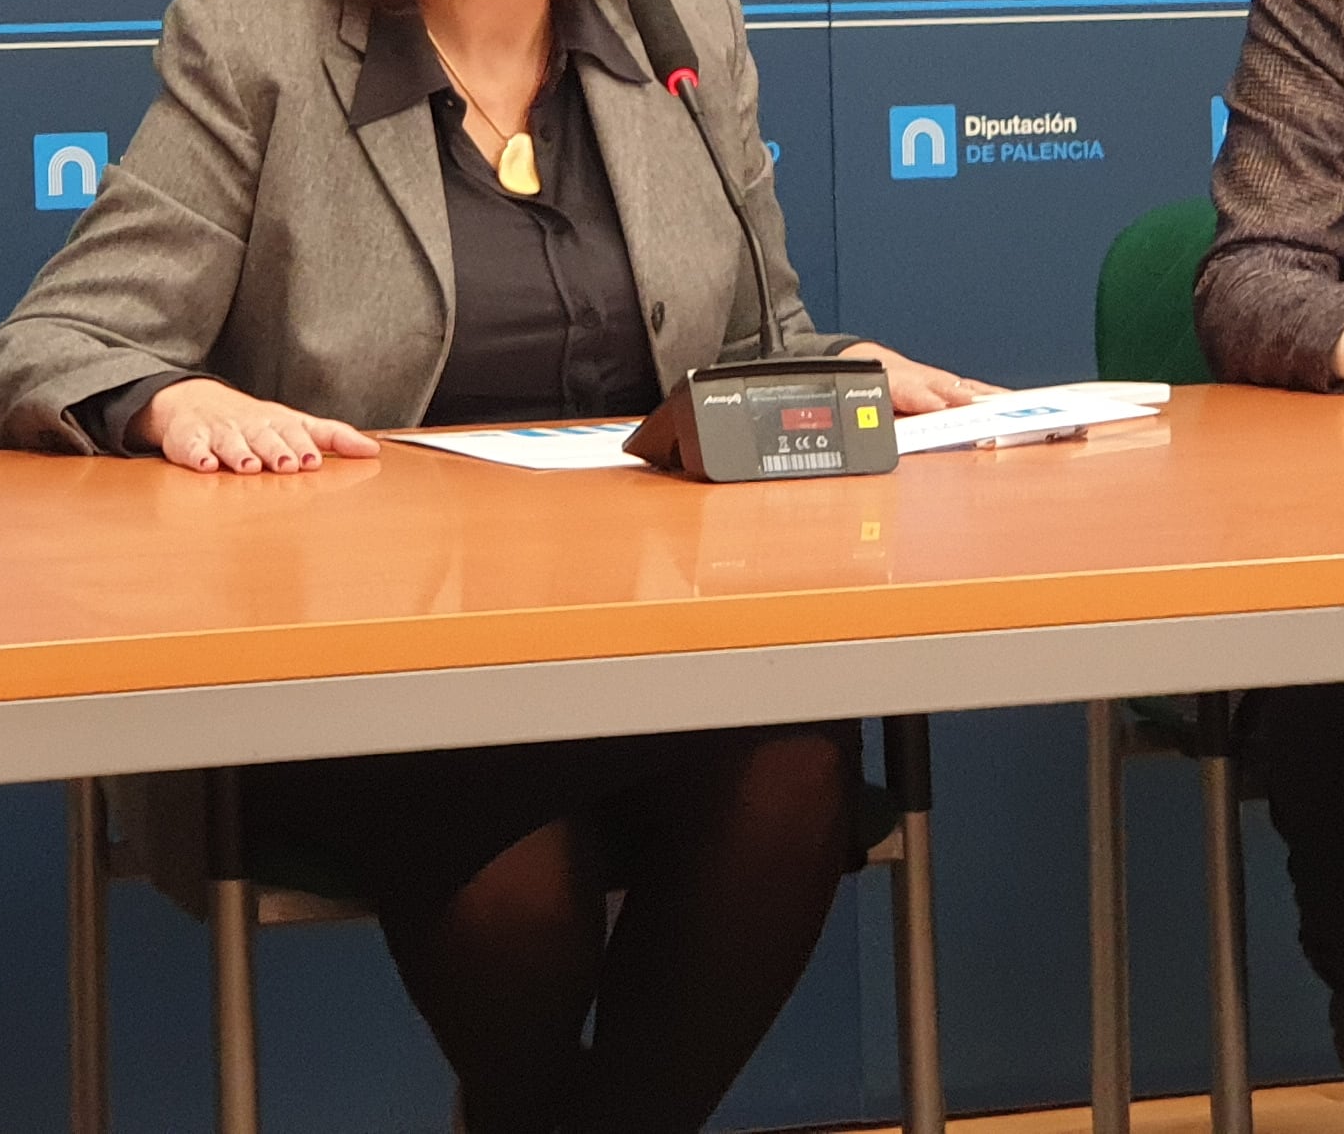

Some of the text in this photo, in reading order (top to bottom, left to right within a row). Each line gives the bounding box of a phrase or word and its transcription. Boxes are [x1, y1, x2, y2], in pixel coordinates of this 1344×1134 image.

[965, 114, 1077, 140] Diputación
[965, 140, 1105, 163] DE PALENCIA
